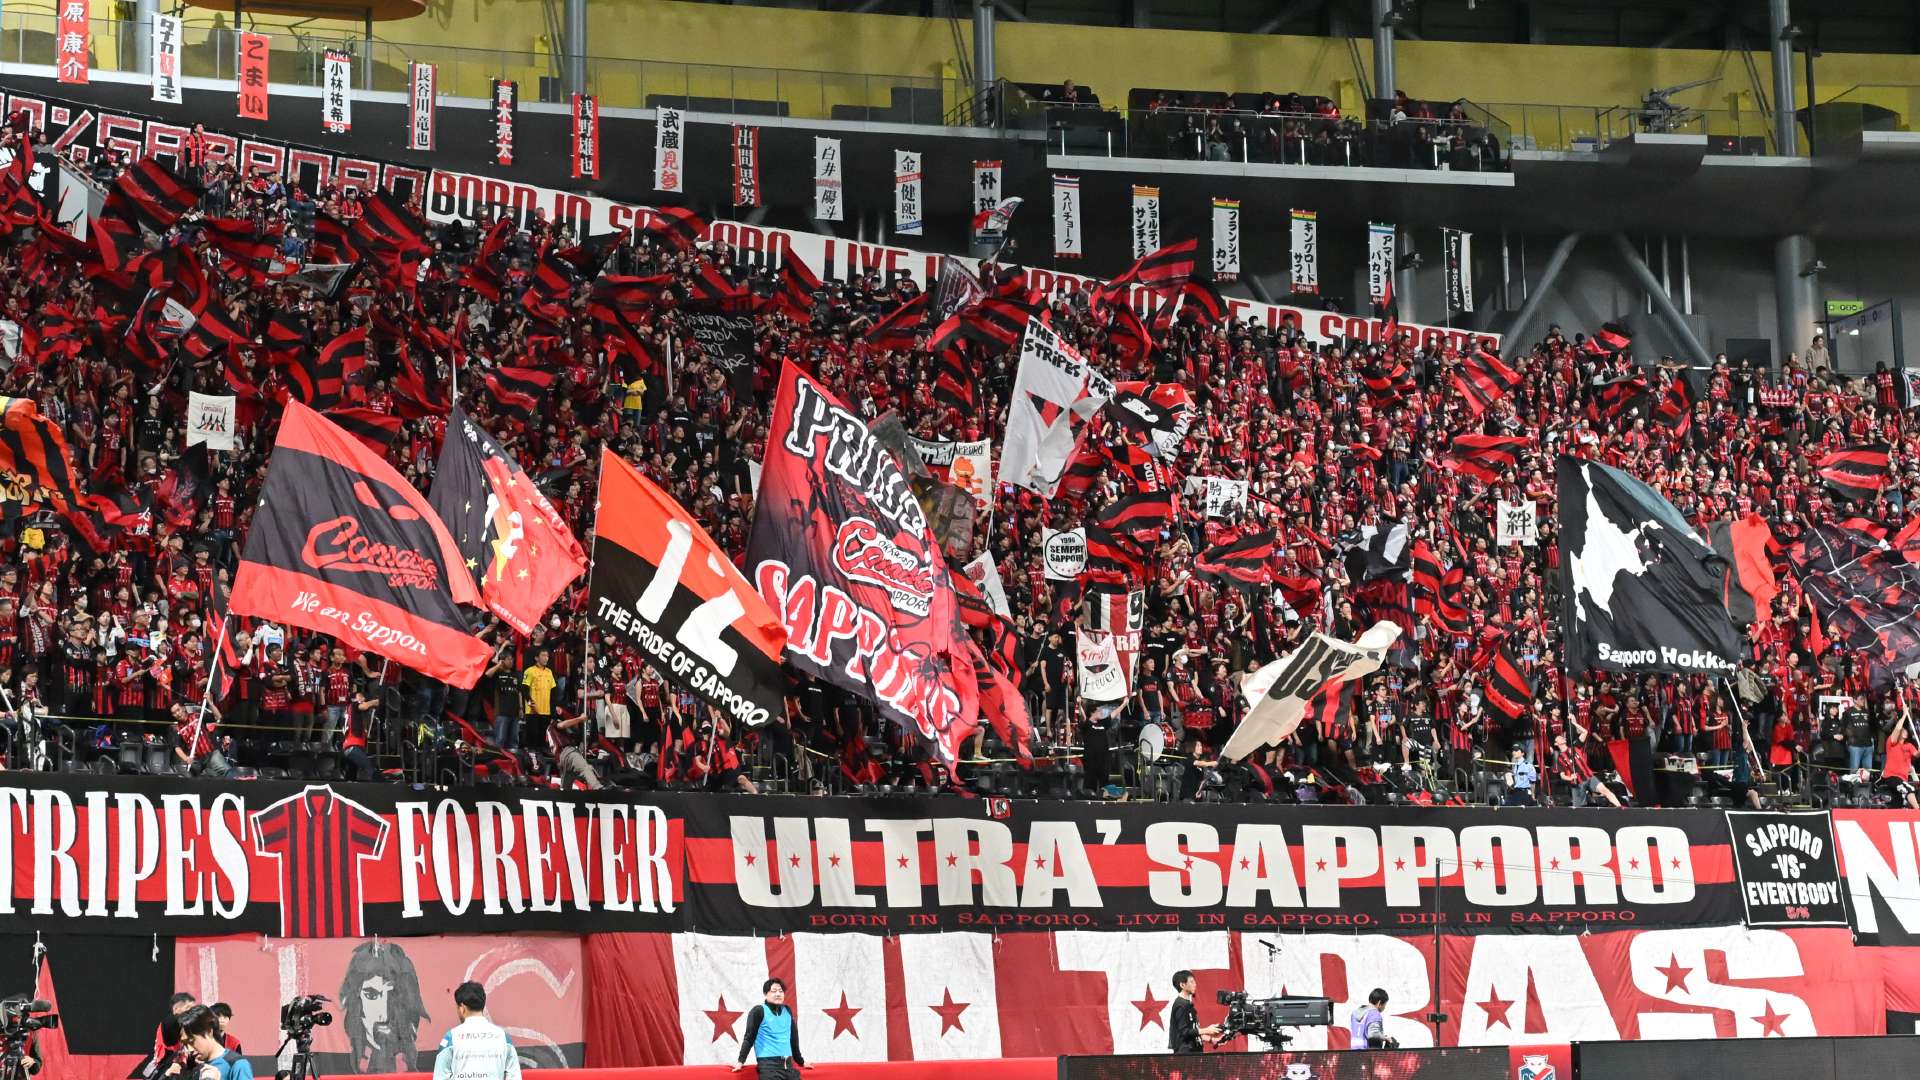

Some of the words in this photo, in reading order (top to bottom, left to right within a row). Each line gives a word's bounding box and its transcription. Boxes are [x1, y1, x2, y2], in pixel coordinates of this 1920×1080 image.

[63, 2, 84, 80] 原康介
[245, 39, 264, 114] こまい
[330, 62, 344, 122] 小林祐希
[416, 67, 430, 147] 長谷川竜也
[330, 123, 345, 134] 99
[555, 193, 591, 245] IN
[1216, 248, 1227, 271] カン
[1028, 320, 1054, 346] THE
[1208, 481, 1222, 513] 駒井
[1506, 509, 1532, 536] 絆
[291, 592, 320, 613] We
[598, 597, 632, 631] THE
[629, 621, 676, 664] PRIDE
[671, 650, 694, 678] OF
[690, 667, 769, 727] SAPPORO
[396, 798, 677, 919] FOREVER
[1746, 824, 1823, 860] SAPPORO
[729, 815, 1122, 908] ULTRA'
[1145, 822, 1695, 907] SAPPORO
[1747, 881, 1838, 906] EVERYBODY
[810, 912, 888, 927] BORN
[908, 912, 938, 926] IN
[959, 912, 1099, 927] SAPPORO,
[1117, 913, 1180, 926] LIVE
[1200, 913, 1226, 925] IN
[1244, 913, 1379, 926] SAPPORO,
[1400, 912, 1448, 925] DIE
[1465, 912, 1492, 924] IN
[1511, 910, 1635, 923] SAPPORO
